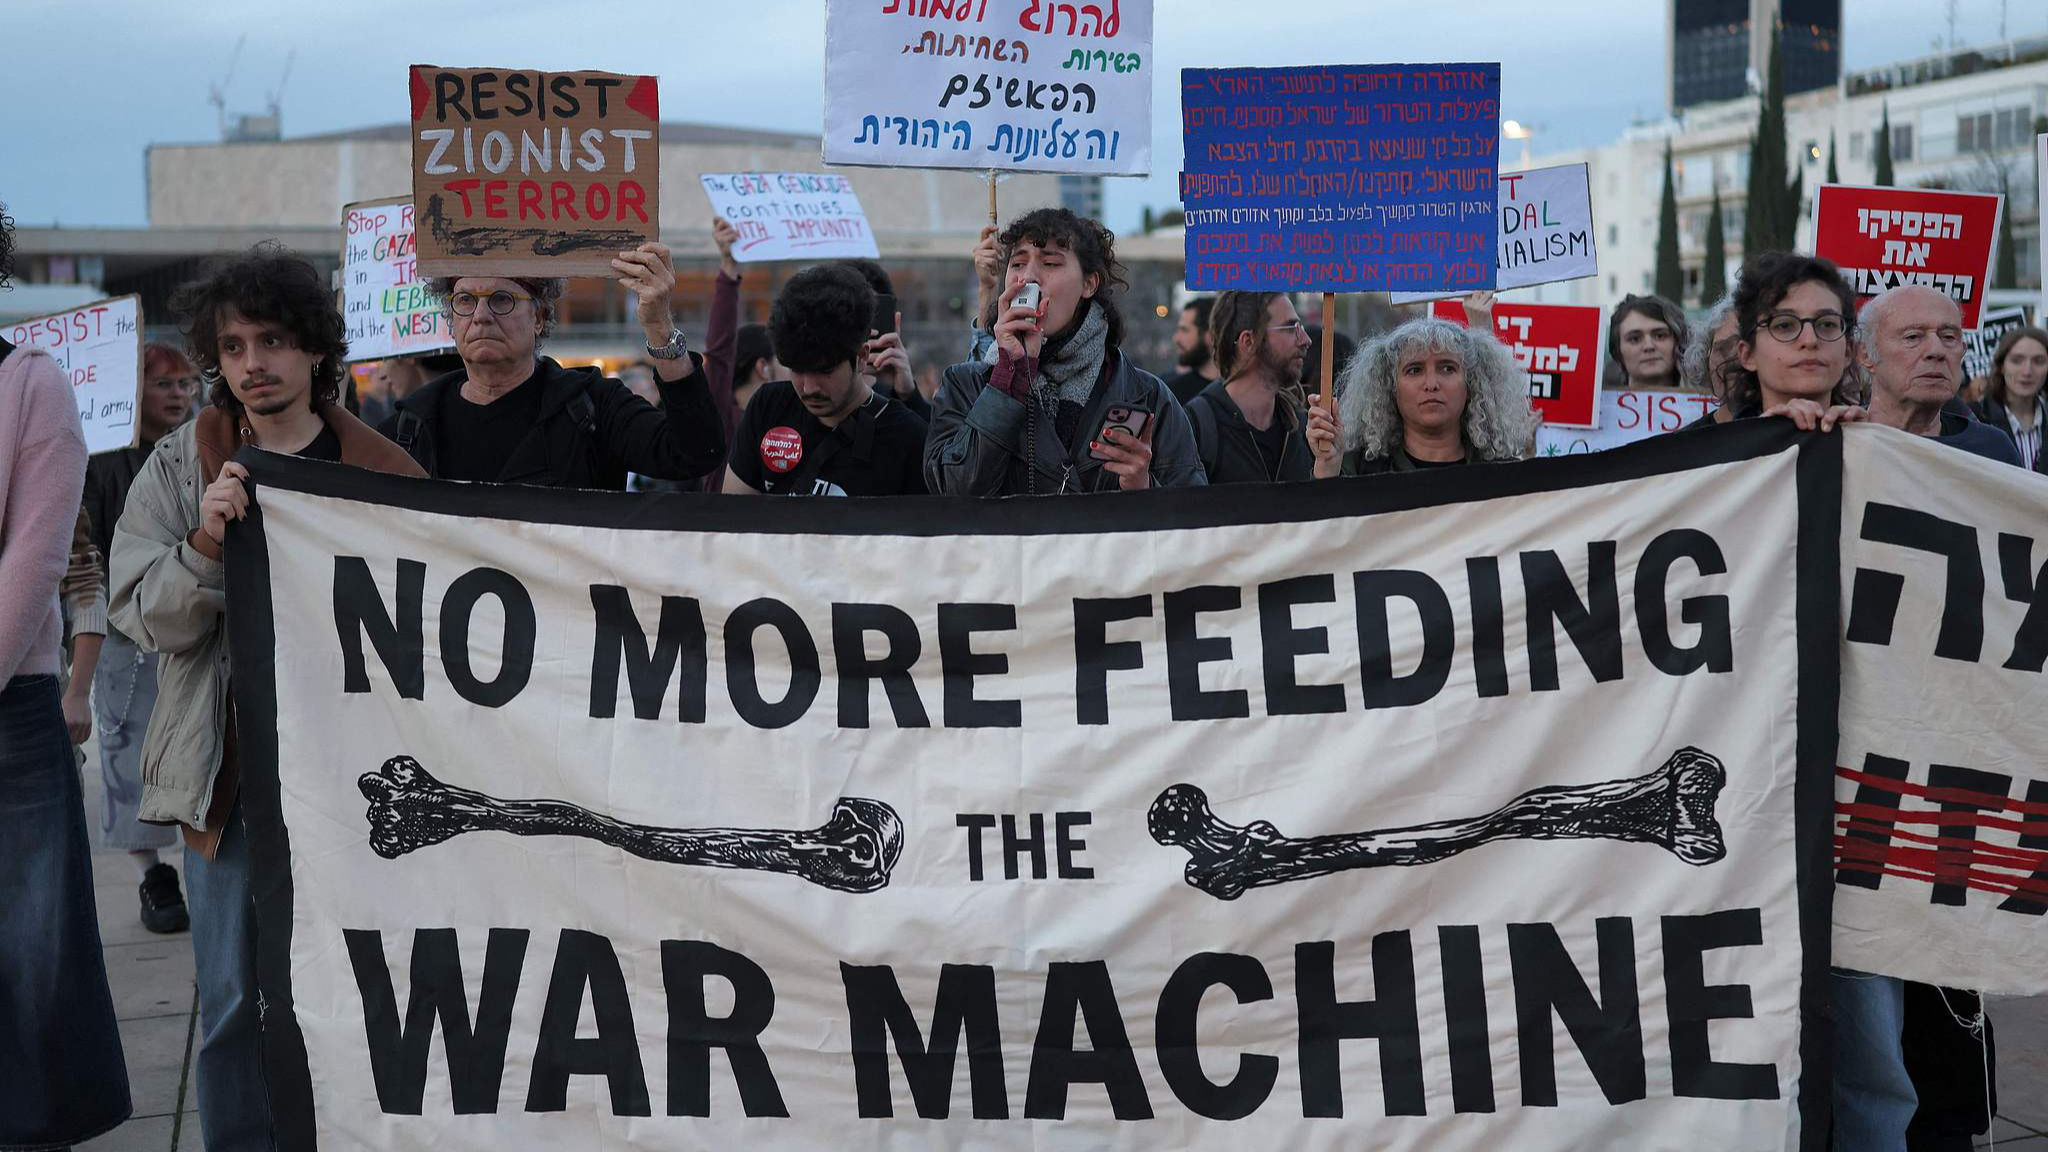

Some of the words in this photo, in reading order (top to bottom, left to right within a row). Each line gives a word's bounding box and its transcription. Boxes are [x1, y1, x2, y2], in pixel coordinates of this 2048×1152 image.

[1062, 49, 1141, 73] בשירות
[435, 72, 622, 122] RESIST
[938, 73, 1097, 114] הפאשיזם
[1208, 75, 1265, 95] הארץ
[1286, 101, 1338, 126] ישראל
[1344, 98, 1369, 125] של
[1374, 103, 1431, 122] הטרור
[853, 114, 972, 151] היהודית
[987, 117, 1120, 163] והעליונות
[1452, 131, 1471, 156] כל
[1475, 132, 1497, 156] על
[420, 127, 652, 176] ZIONIST
[1208, 142, 1259, 162] הצבא
[1432, 135, 1447, 160] מי
[731, 174, 770, 196] GAZA
[777, 174, 853, 194] GENOCIDE
[443, 179, 649, 223] TERROR
[1308, 204, 1334, 222] בלב
[1338, 202, 1373, 221] לפעול
[1419, 203, 1456, 217] הטרור
[1461, 201, 1492, 222] ארגון
[348, 211, 387, 236] Stop
[1185, 208, 1228, 227] אזרחיים
[1232, 207, 1270, 225] אזורים
[1274, 208, 1304, 229] ומתוך
[1376, 204, 1415, 227] ממשיך
[1857, 208, 1963, 240] הפסיקו
[780, 218, 865, 240] IMPUNITY
[1254, 233, 1283, 252] את
[1497, 230, 1589, 269] IALISM
[1881, 239, 1931, 267] את
[347, 245, 368, 266] the
[354, 270, 367, 285] in
[1305, 258, 1357, 284] לצאת
[1362, 263, 1379, 281] או
[349, 293, 371, 313] and
[369, 316, 386, 336] the
[395, 311, 440, 338] WEST
[1497, 315, 1533, 341] די
[1514, 341, 1580, 372] למל
[101, 401, 133, 428] army
[1617, 391, 1715, 432] SIST
[333, 555, 536, 708] NO
[589, 583, 1022, 729] MORE
[1073, 528, 1733, 725] FEEDING
[956, 812, 1095, 881] THE
[342, 928, 791, 1118] WAR
[839, 907, 1780, 1121] MACHINE
